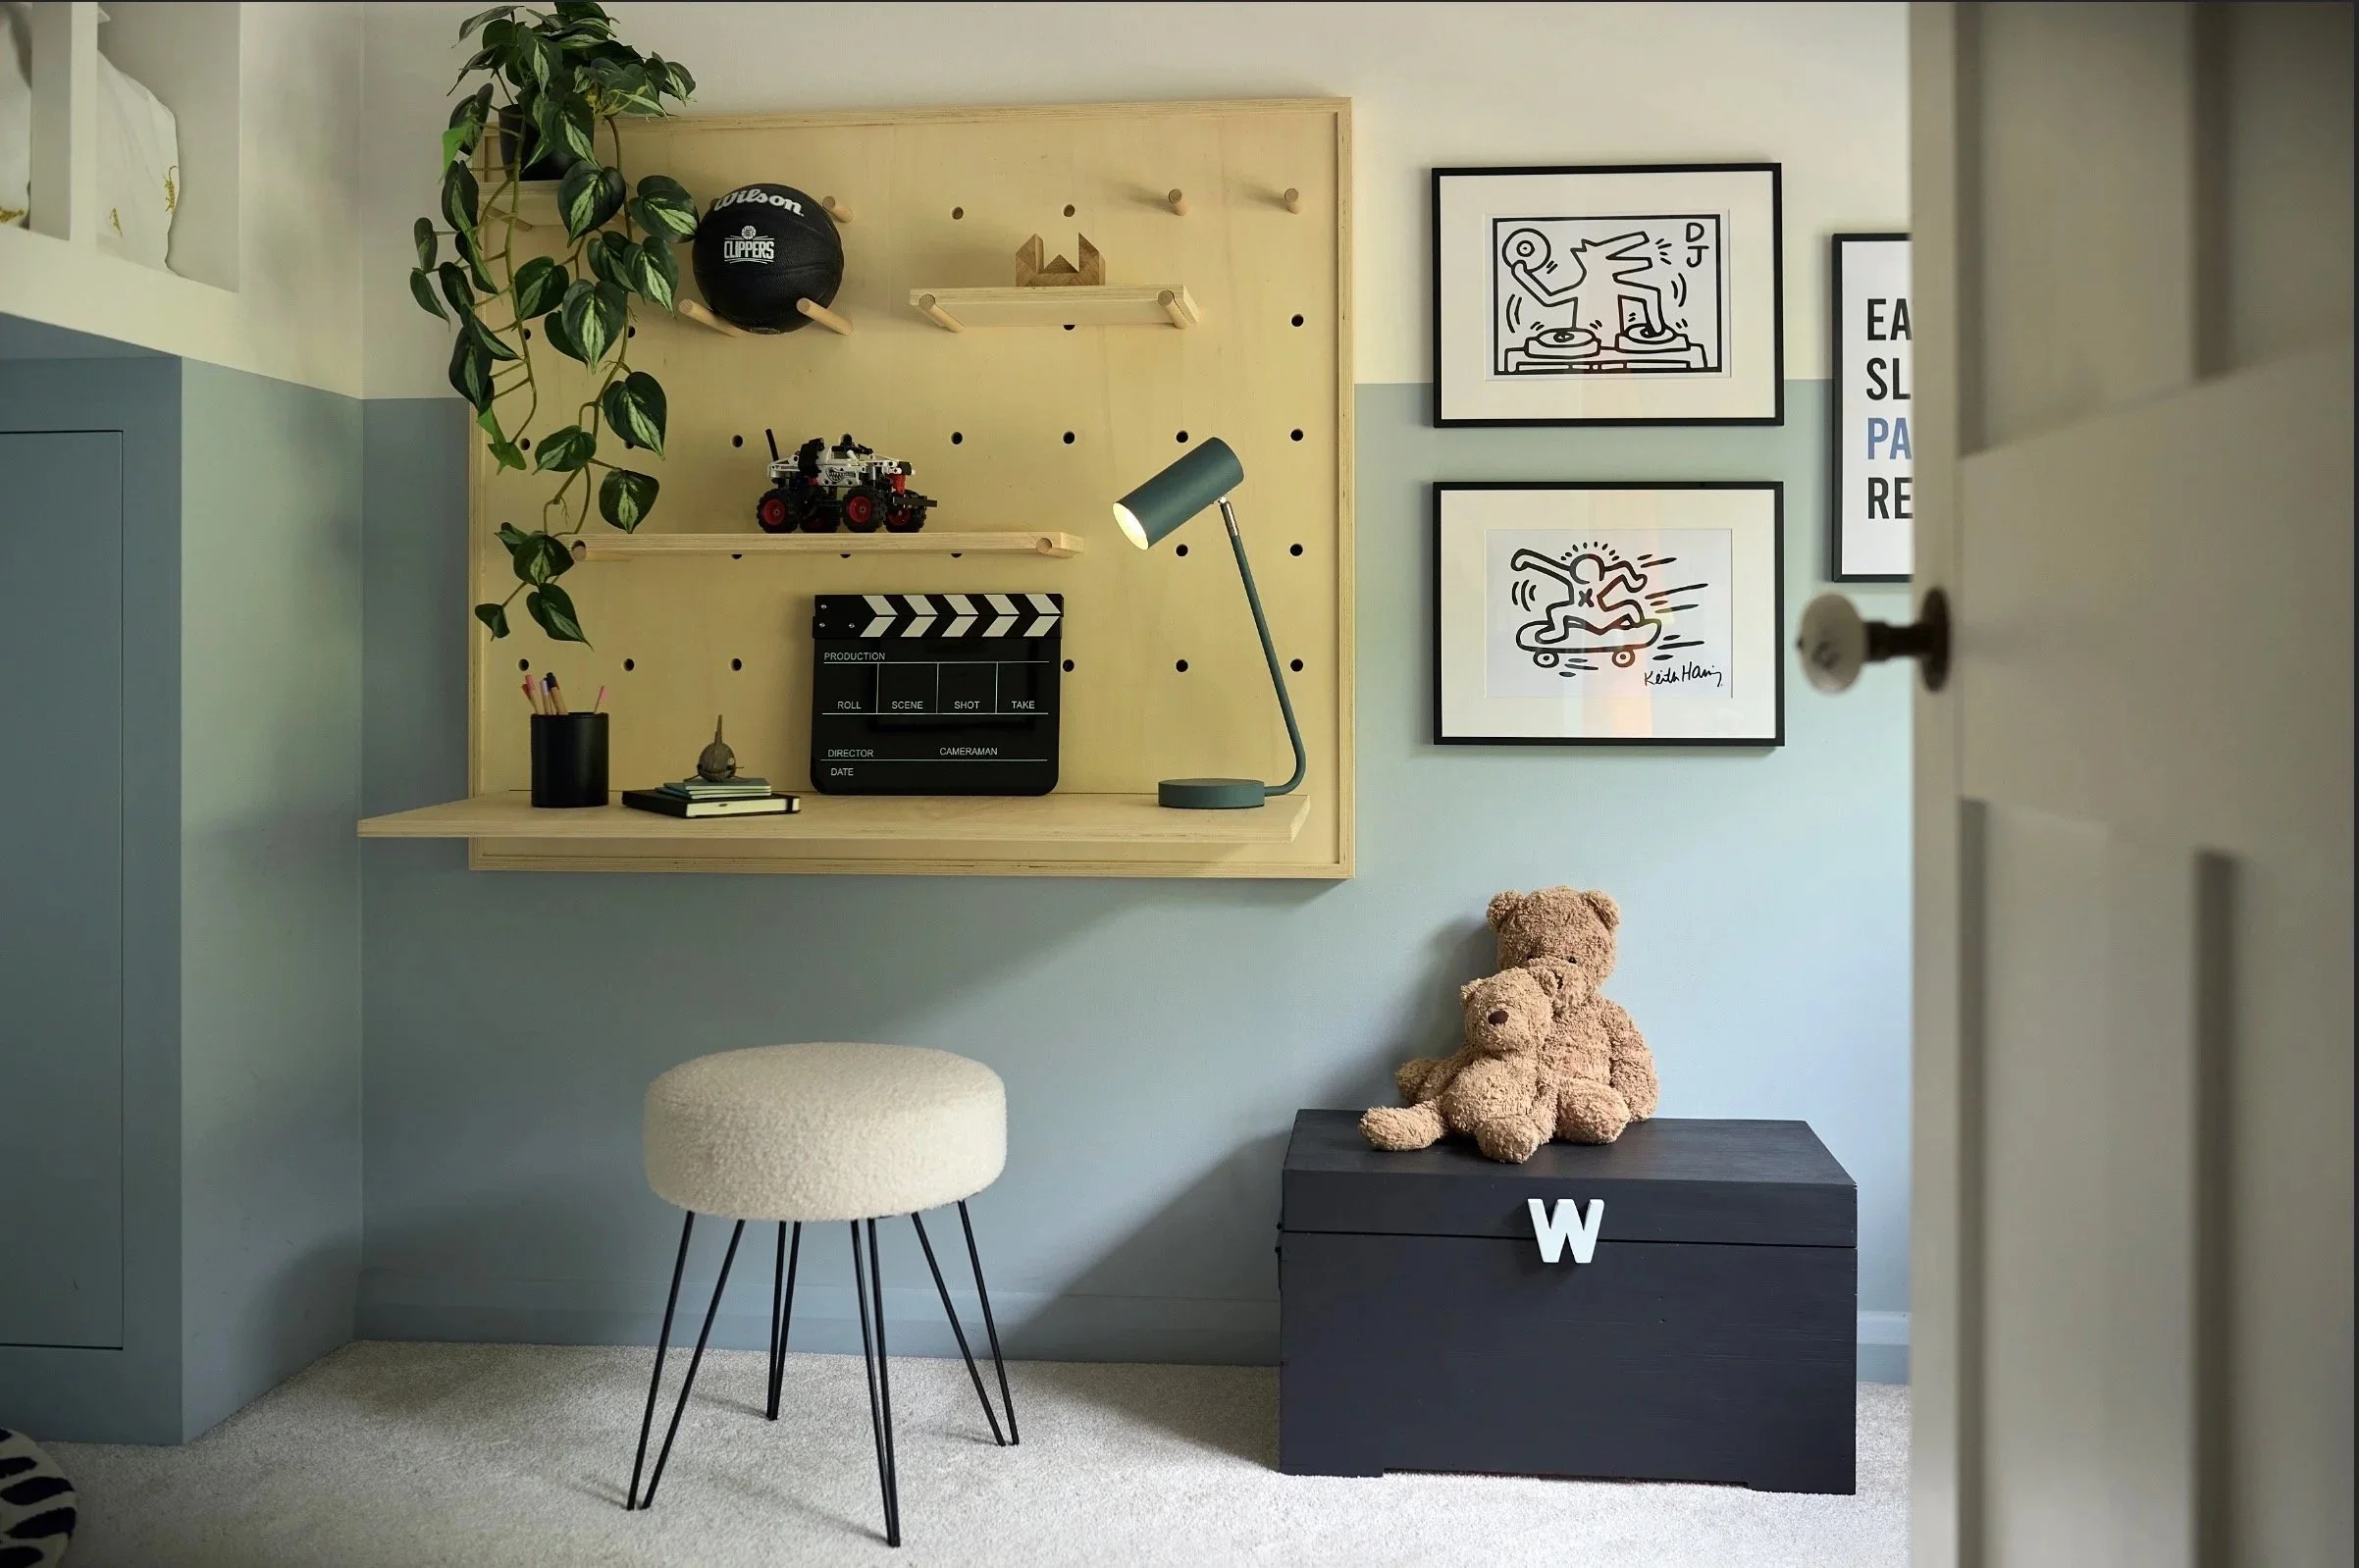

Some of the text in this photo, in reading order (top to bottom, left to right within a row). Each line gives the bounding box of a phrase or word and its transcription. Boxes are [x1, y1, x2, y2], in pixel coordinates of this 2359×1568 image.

[714, 188, 805, 217] Wilson
[724, 240, 775, 259] CLIPPERS
[1867, 298, 1913, 340] EA
[823, 652, 886, 661] PRODUCTION
[1012, 701, 1035, 709] TAKE
[827, 747, 998, 758] DIRECTOR CAMERAMAN
[830, 767, 855, 777] DATE
[1527, 1198, 1605, 1264] W
